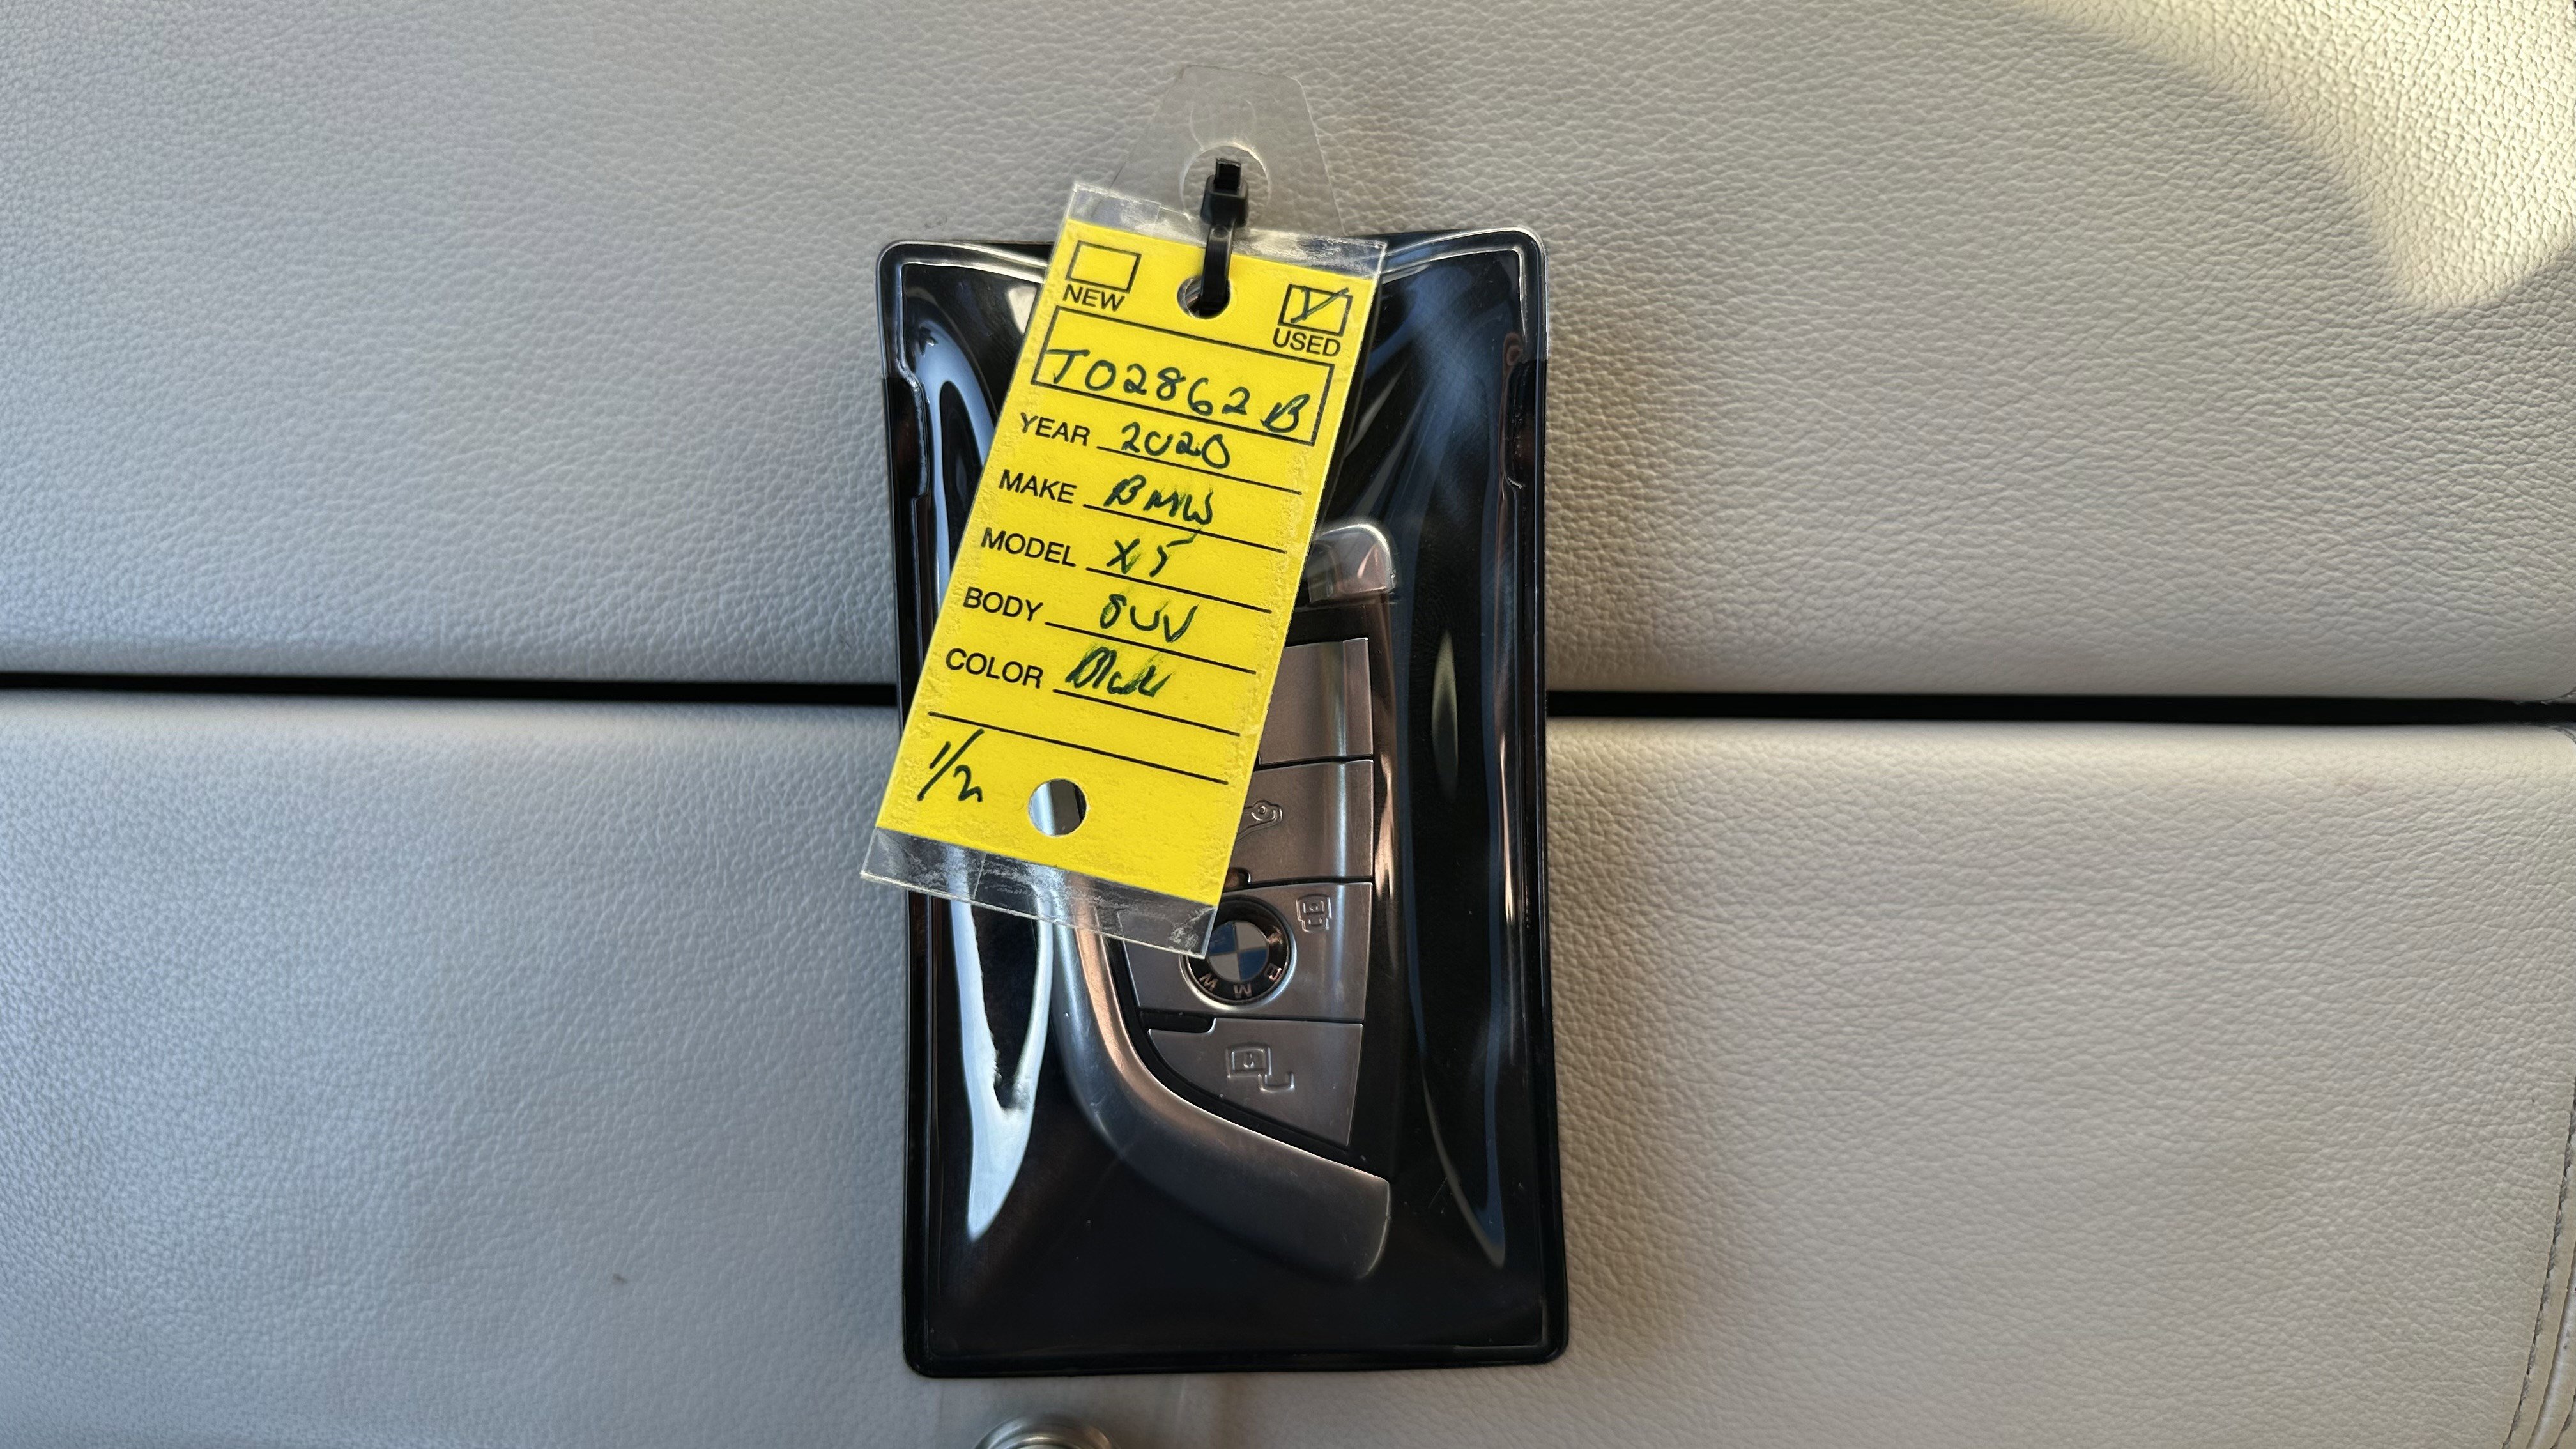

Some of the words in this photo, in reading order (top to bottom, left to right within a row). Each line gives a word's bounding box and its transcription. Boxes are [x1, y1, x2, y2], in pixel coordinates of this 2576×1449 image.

[1062, 285, 1125, 312] NEW
[1271, 328, 1341, 358] USED
[1020, 412, 1091, 447] YEAR
[1121, 421, 1230, 469] 2020
[999, 468, 1077, 504] MAKE
[1103, 473, 1214, 526] BMW
[981, 527, 1076, 567] MODEL
[1106, 526, 1201, 577] X5
[963, 586, 1044, 622] BODY
[1100, 593, 1199, 643] SUV
[946, 648, 1044, 689] COLOR
[917, 728, 986, 802] 1/2
